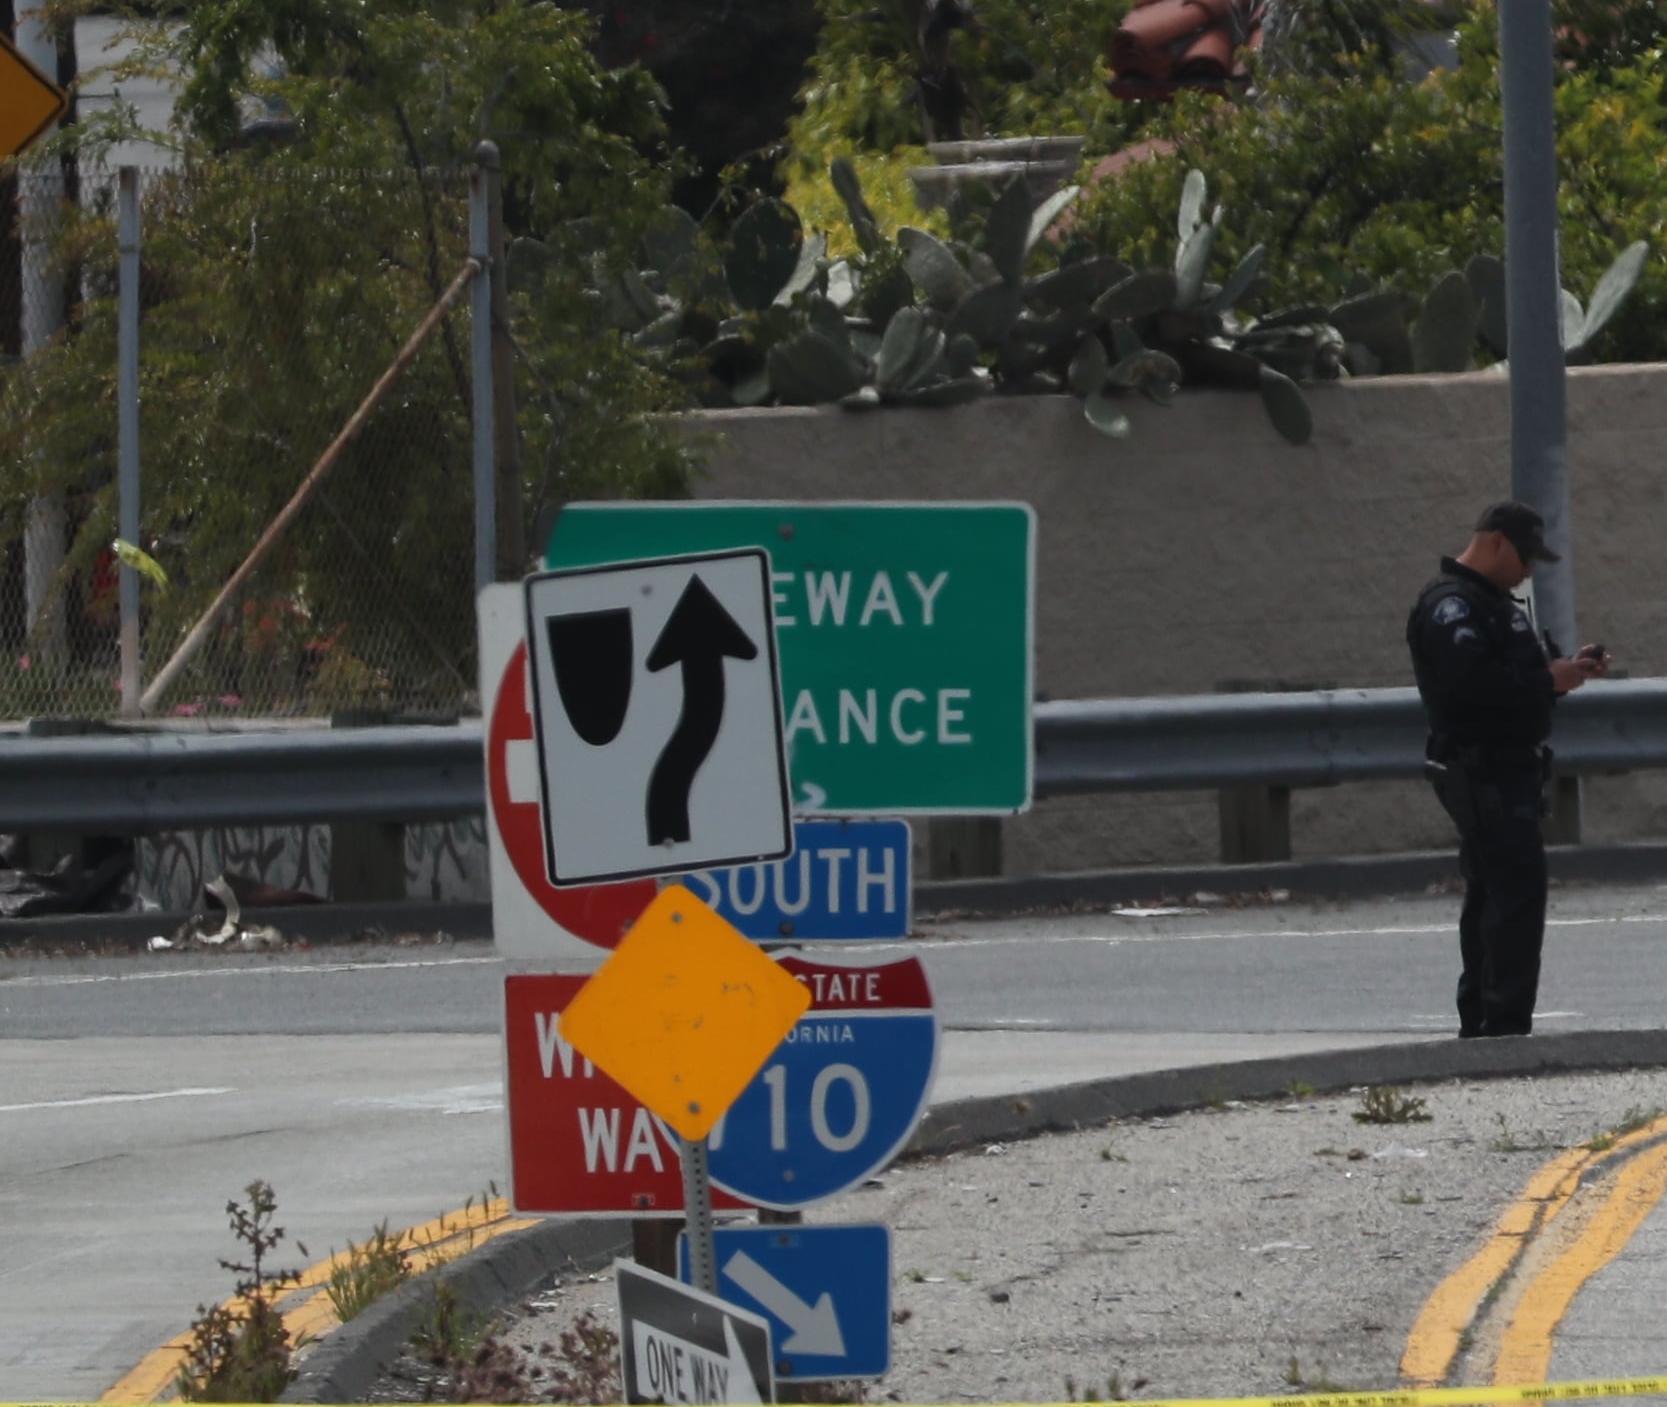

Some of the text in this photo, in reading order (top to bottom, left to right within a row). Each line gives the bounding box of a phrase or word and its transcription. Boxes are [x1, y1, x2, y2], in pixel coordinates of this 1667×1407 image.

[771, 570, 949, 627] EWAY
[785, 687, 973, 745] ANCE
[793, 973, 882, 1003] TATE
[784, 1024, 855, 1043] ORNIA
[577, 1106, 664, 1173] WA
[647, 1335, 729, 1405] ONE WAY
